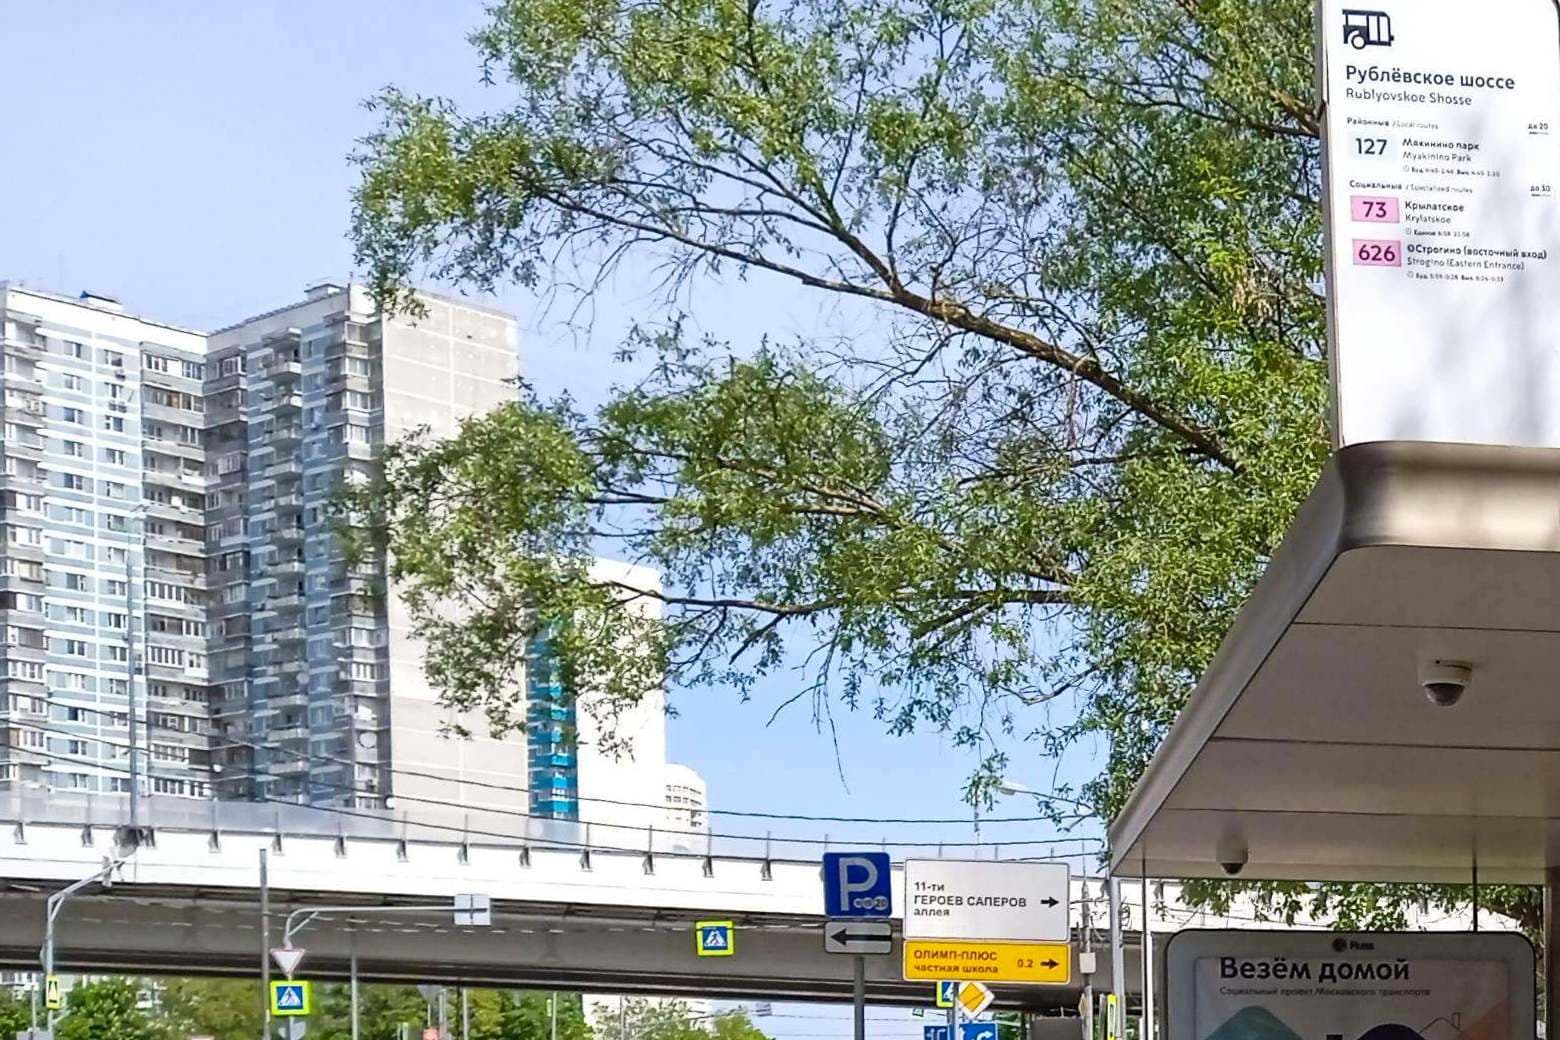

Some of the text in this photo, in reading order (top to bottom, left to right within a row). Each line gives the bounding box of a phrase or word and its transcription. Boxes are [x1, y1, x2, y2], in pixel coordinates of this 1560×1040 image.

[1345, 65, 1516, 90] Рублёвское шоссе
[1345, 88, 1473, 106] Rublyovskoe Shosse
[1355, 137, 1388, 156] 127
[1455, 141, 1480, 151] парк
[1451, 152, 1472, 162] Park
[1362, 200, 1388, 218] 73
[1404, 200, 1465, 214] Крылатское
[1405, 214, 1452, 225] Krylatskoe
[1357, 244, 1396, 262] 626
[1415, 243, 1461, 255] Строгино
[914, 882, 945, 892] 11-ти
[914, 895, 1028, 908] ГЕРОЕВ САПЕРОВ
[913, 908, 950, 917] аллея
[913, 950, 998, 961] ОЛИМП-ПЛЮС
[914, 964, 999, 974] частная школа
[1017, 958, 1034, 969] 0.2
[1220, 957, 1410, 984] Везём домой
